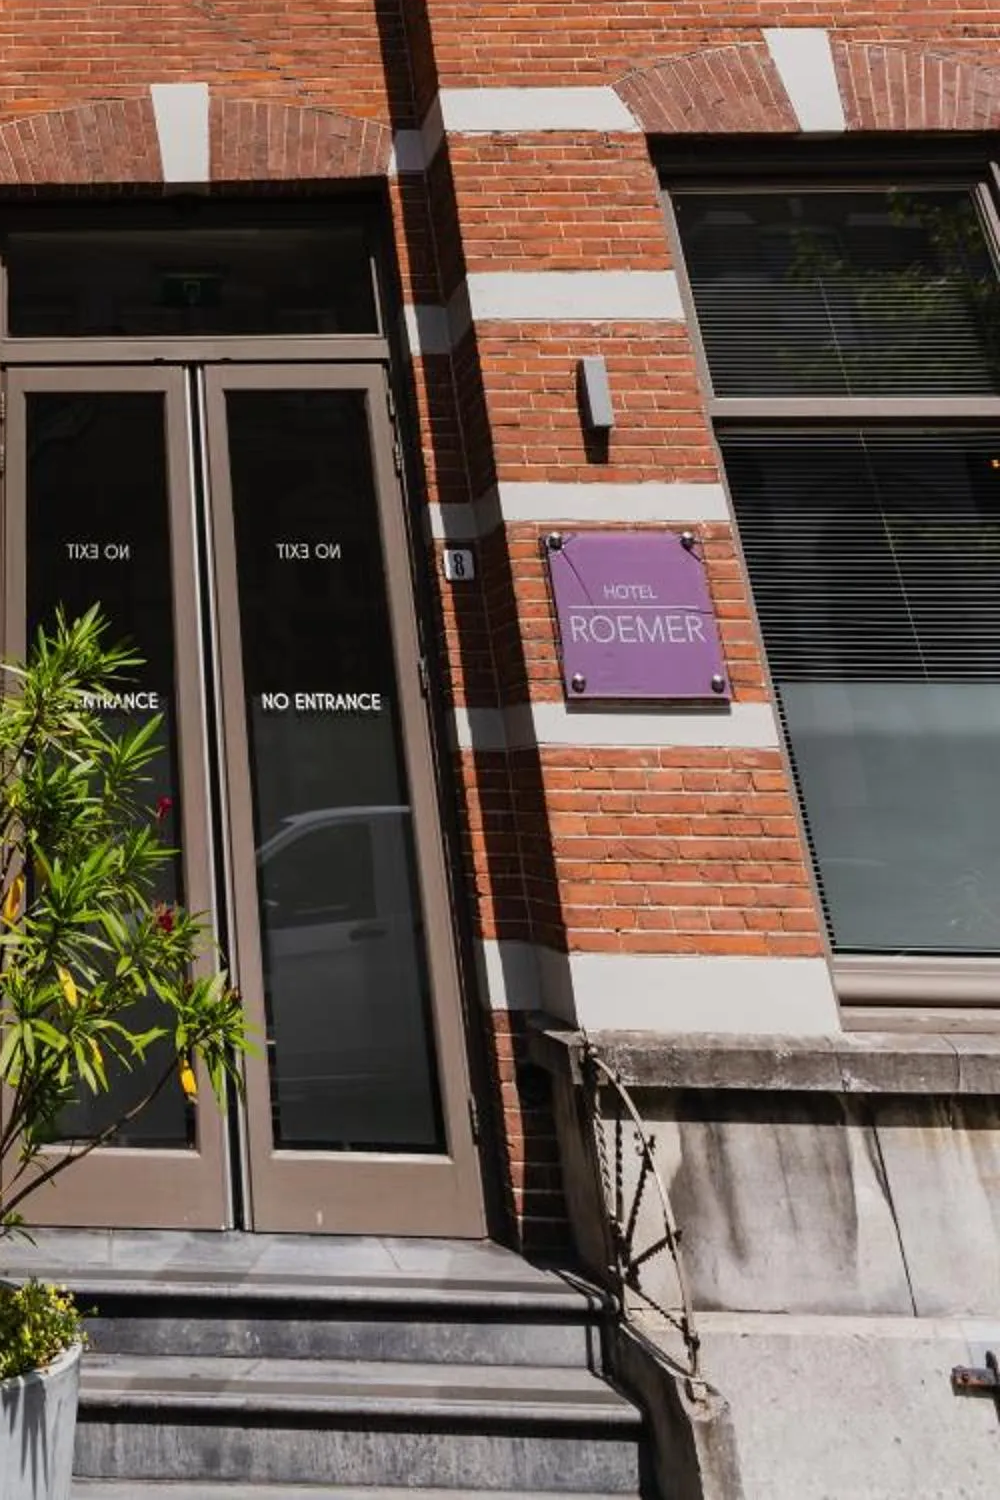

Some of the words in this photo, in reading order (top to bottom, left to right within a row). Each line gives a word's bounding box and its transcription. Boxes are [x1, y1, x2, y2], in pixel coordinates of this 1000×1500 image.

[453, 552, 465, 577] 8
[603, 585, 658, 600] HOTEL
[570, 614, 707, 643] ROEMER
[75, 692, 159, 709] NTRANCE
[261, 692, 289, 710] NO
[295, 692, 381, 710] ENTRANCE
